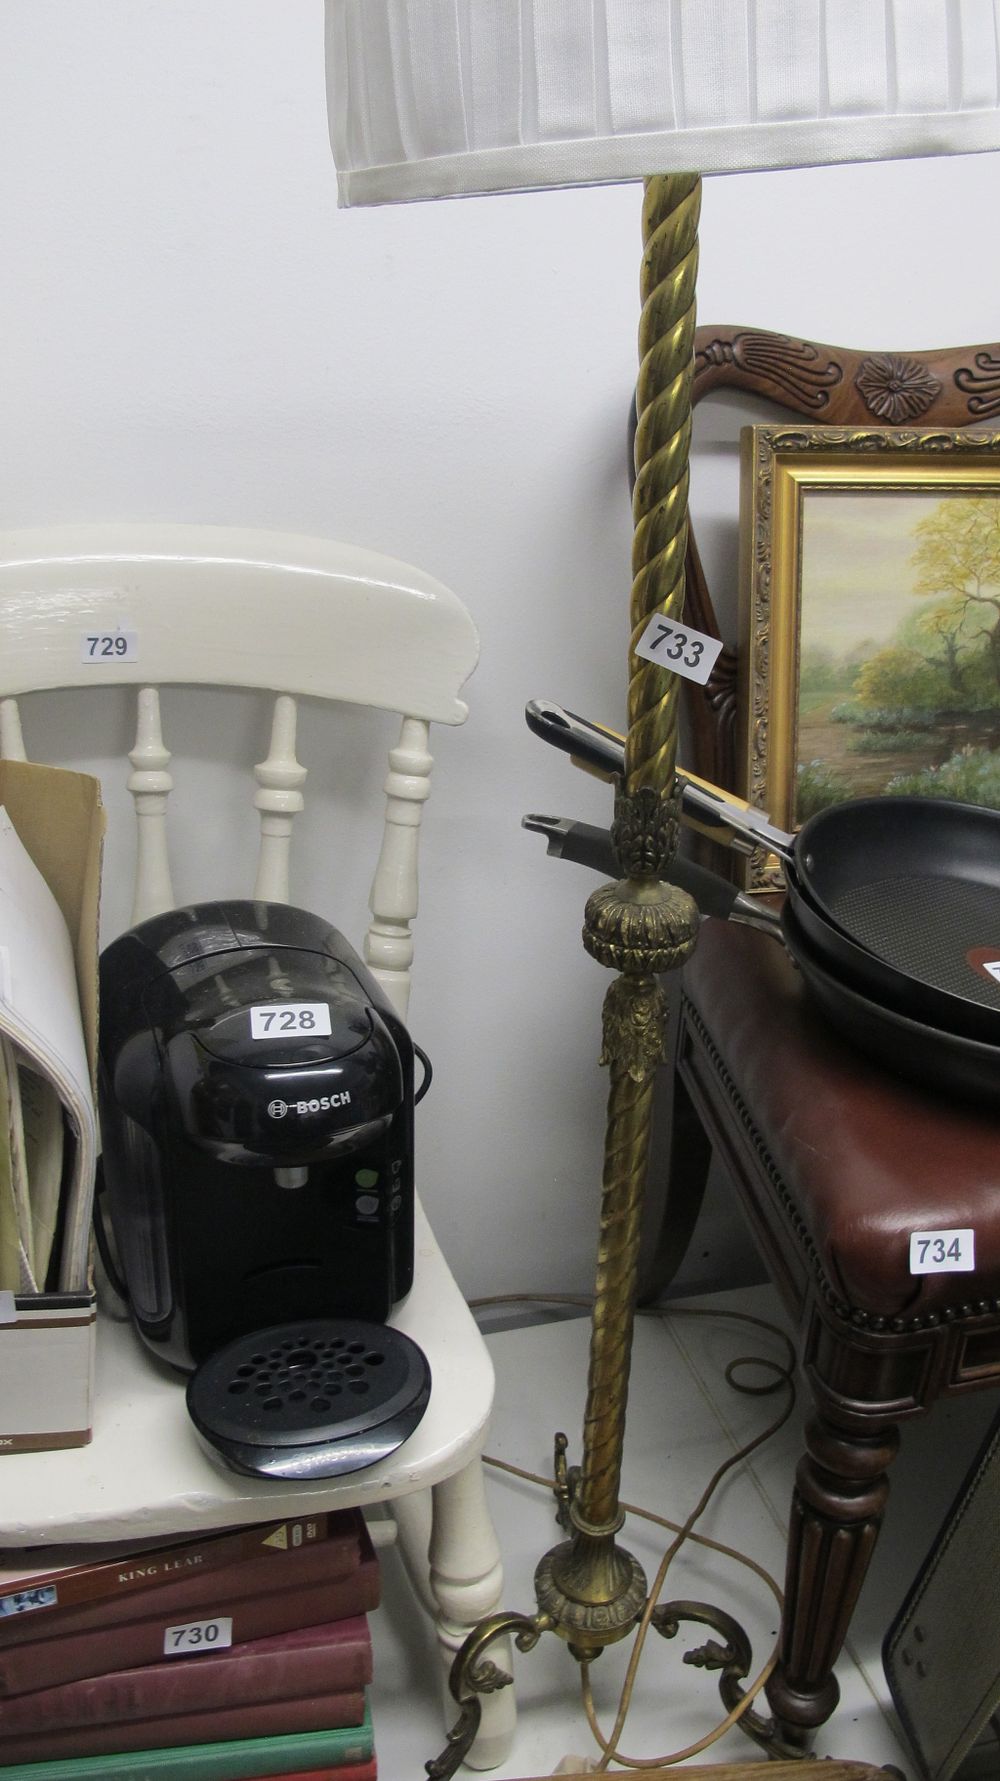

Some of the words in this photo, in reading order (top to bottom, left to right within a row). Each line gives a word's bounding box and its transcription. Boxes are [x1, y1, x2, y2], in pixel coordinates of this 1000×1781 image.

[87, 637, 127, 656] 729
[649, 624, 704, 668] 733
[259, 1010, 316, 1032] 728
[296, 1091, 351, 1114] BOSCH
[917, 1237, 962, 1264] 734
[118, 1566, 158, 1583] KING
[164, 1555, 203, 1571] LEAR
[172, 1624, 219, 1647] 730
